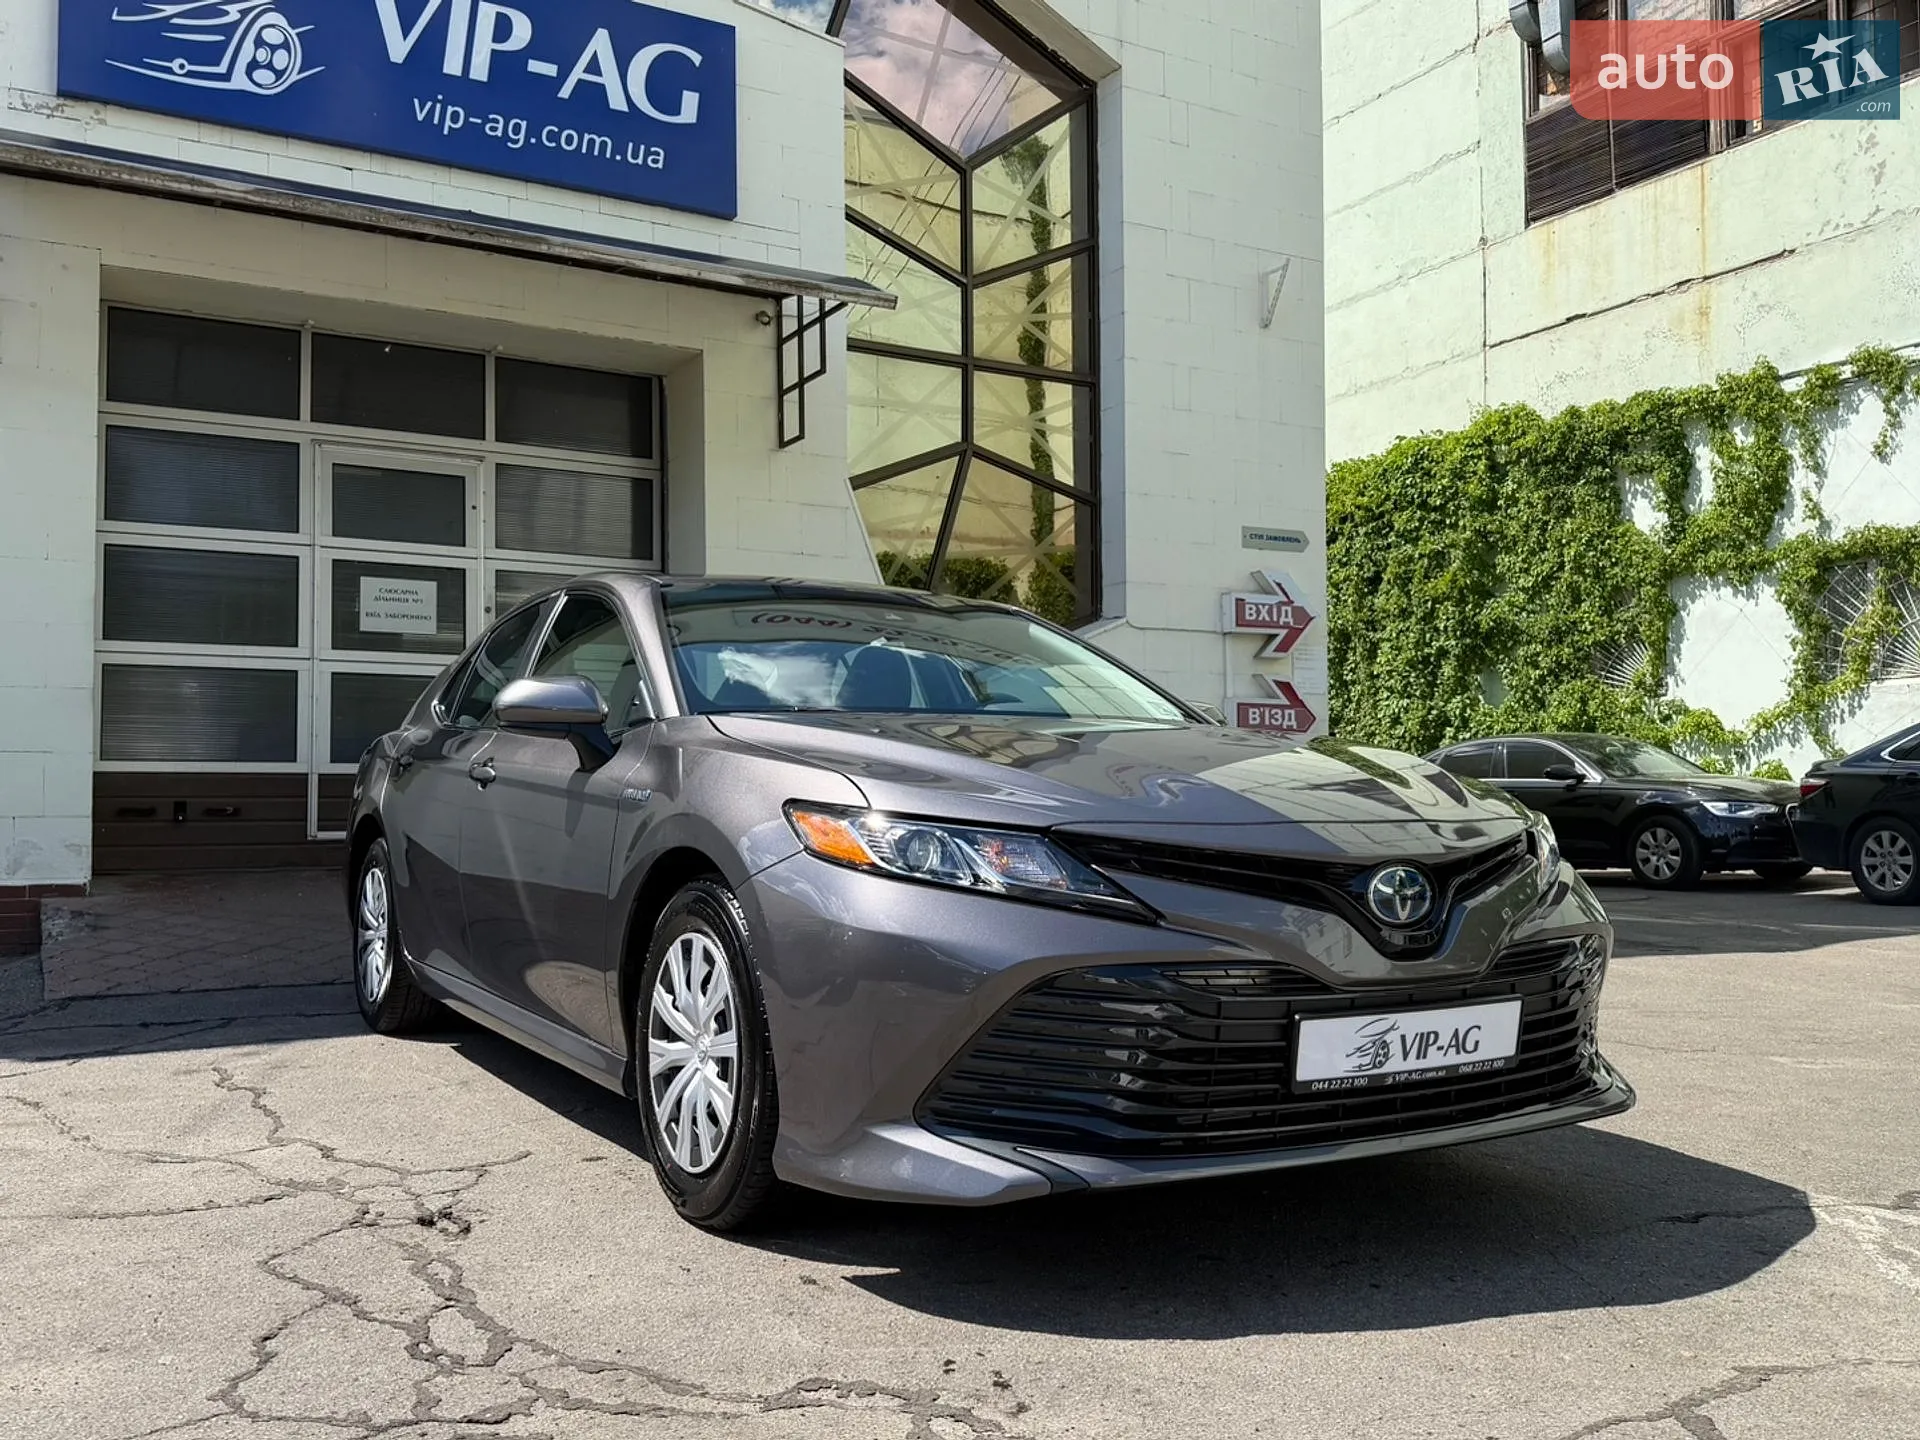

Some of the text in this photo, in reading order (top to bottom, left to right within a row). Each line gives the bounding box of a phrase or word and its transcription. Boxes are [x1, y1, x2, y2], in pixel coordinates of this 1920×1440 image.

[374, 0, 703, 124] VIP-AG
[413, 94, 666, 169] vip-ag.com.ua
[1245, 603, 1294, 626] ВХІД
[1400, 1025, 1481, 1062] VIP-AG
[1311, 1076, 1368, 1091] 044 22 22 100
